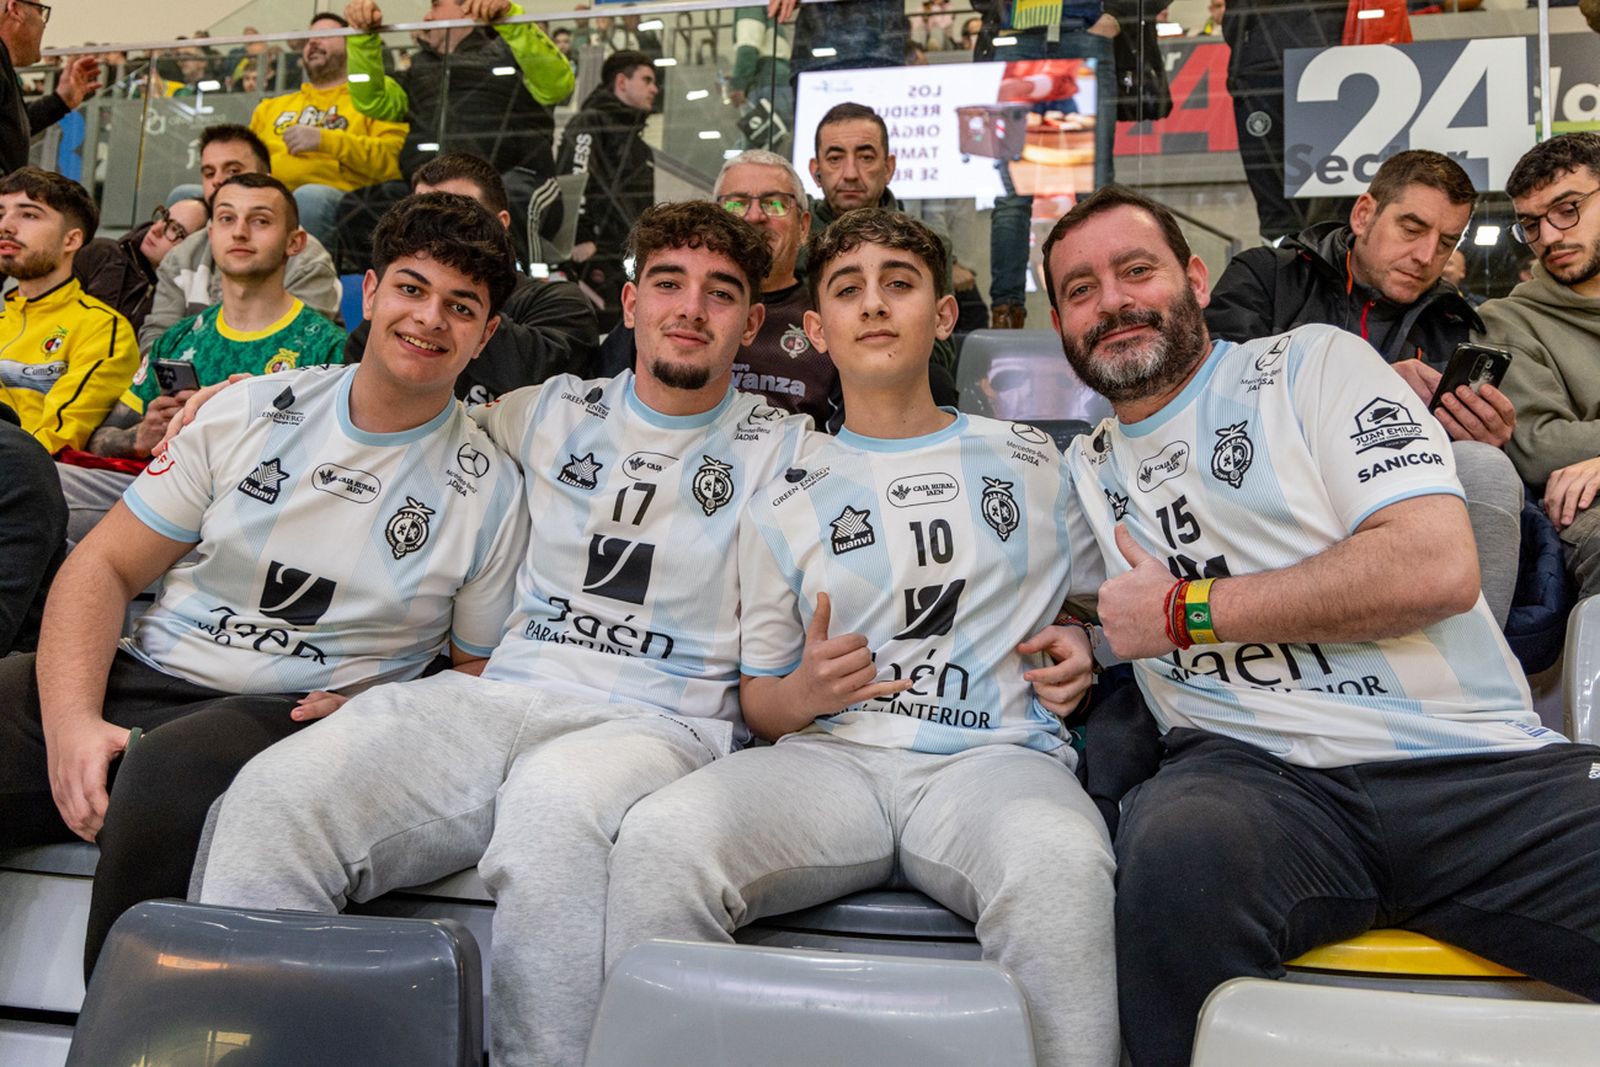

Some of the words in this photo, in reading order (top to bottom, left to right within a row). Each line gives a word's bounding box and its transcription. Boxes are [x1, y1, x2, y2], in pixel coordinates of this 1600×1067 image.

[1294, 36, 1536, 196] 24
[731, 371, 806, 397] vanza
[1356, 429, 1385, 446] JUAN
[1387, 426, 1423, 436] EMILIO
[240, 480, 276, 501] luanvi
[772, 485, 799, 507] GREEN
[931, 482, 956, 491] RURAL
[612, 482, 657, 526] 17
[1156, 494, 1201, 550] 15
[834, 533, 873, 553] luanvi
[909, 518, 955, 568] 10
